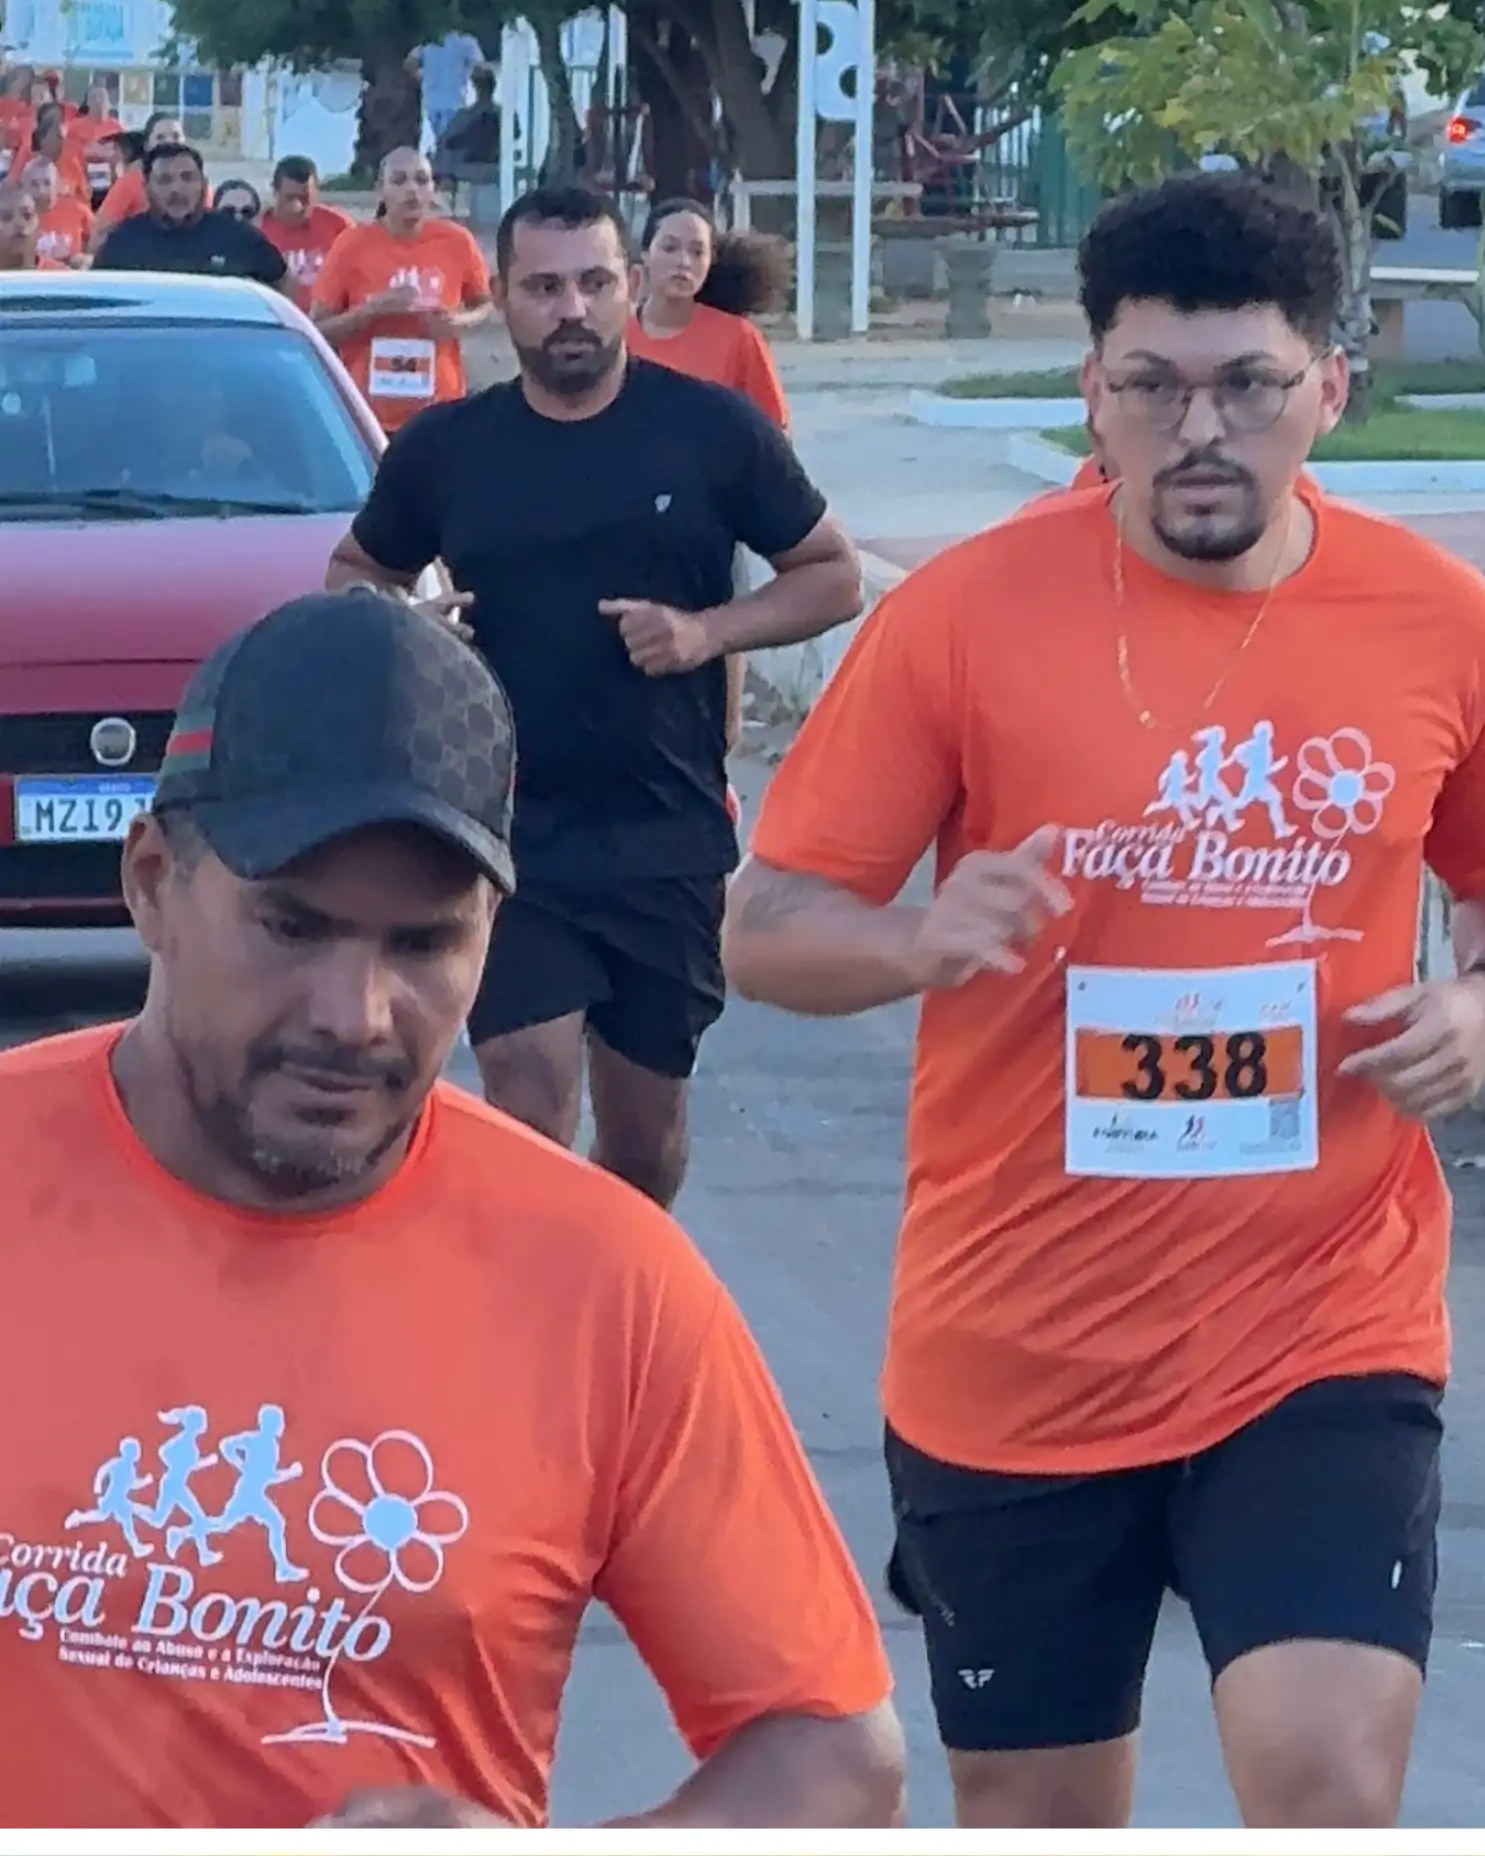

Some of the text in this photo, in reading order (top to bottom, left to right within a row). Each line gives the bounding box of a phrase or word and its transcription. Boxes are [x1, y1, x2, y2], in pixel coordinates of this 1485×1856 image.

[1061, 827, 1351, 889] Faça Bonito
[1121, 1031, 1268, 1100] 338
[131, 1562, 392, 1662] Bonito
